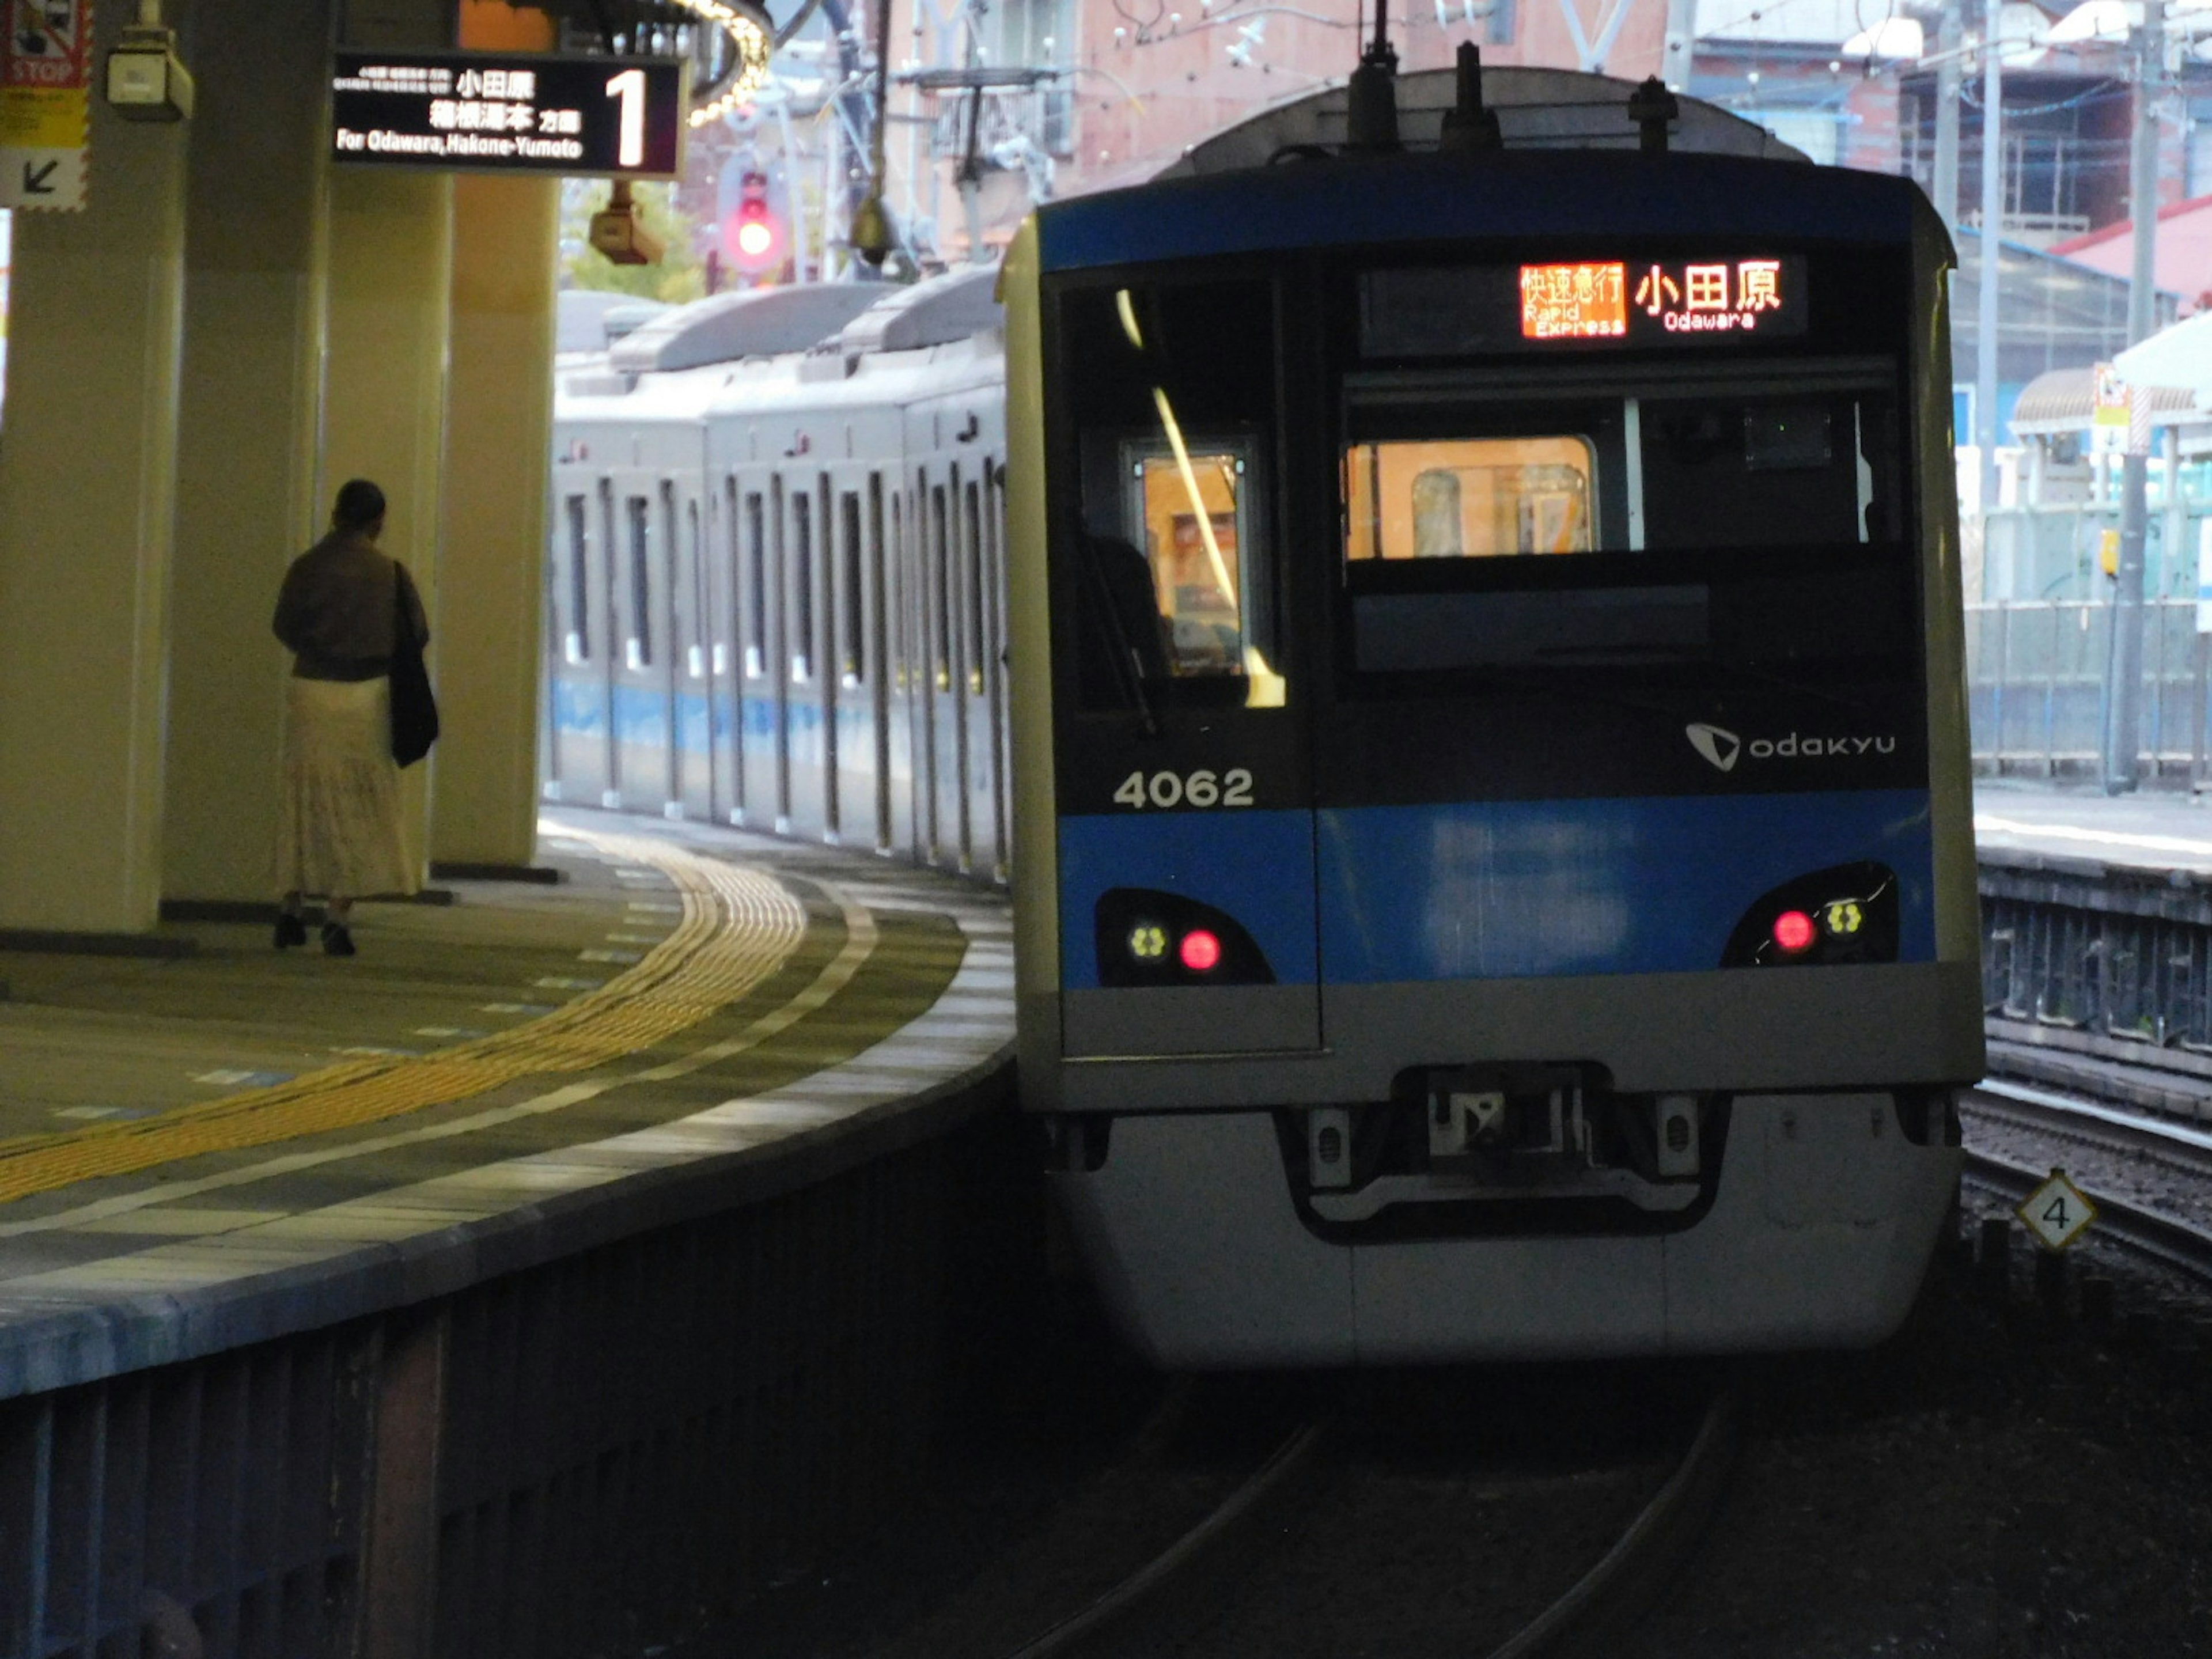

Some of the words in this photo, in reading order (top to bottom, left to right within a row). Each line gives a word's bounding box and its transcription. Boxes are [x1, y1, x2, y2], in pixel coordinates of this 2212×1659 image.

[456, 69, 536, 100] 小田原
[429, 99, 535, 130] 箱根湯本
[605, 69, 645, 167] 1
[336, 128, 366, 150] For
[1521, 266, 1623, 305] 快速急行
[1634, 260, 1782, 315] 小田原
[1524, 302, 1580, 321] Rapid
[1664, 311, 1756, 332] Odawara
[1536, 319, 1626, 336] Express
[1113, 768, 1254, 808] 4062
[2043, 1196, 2070, 1229] 4
